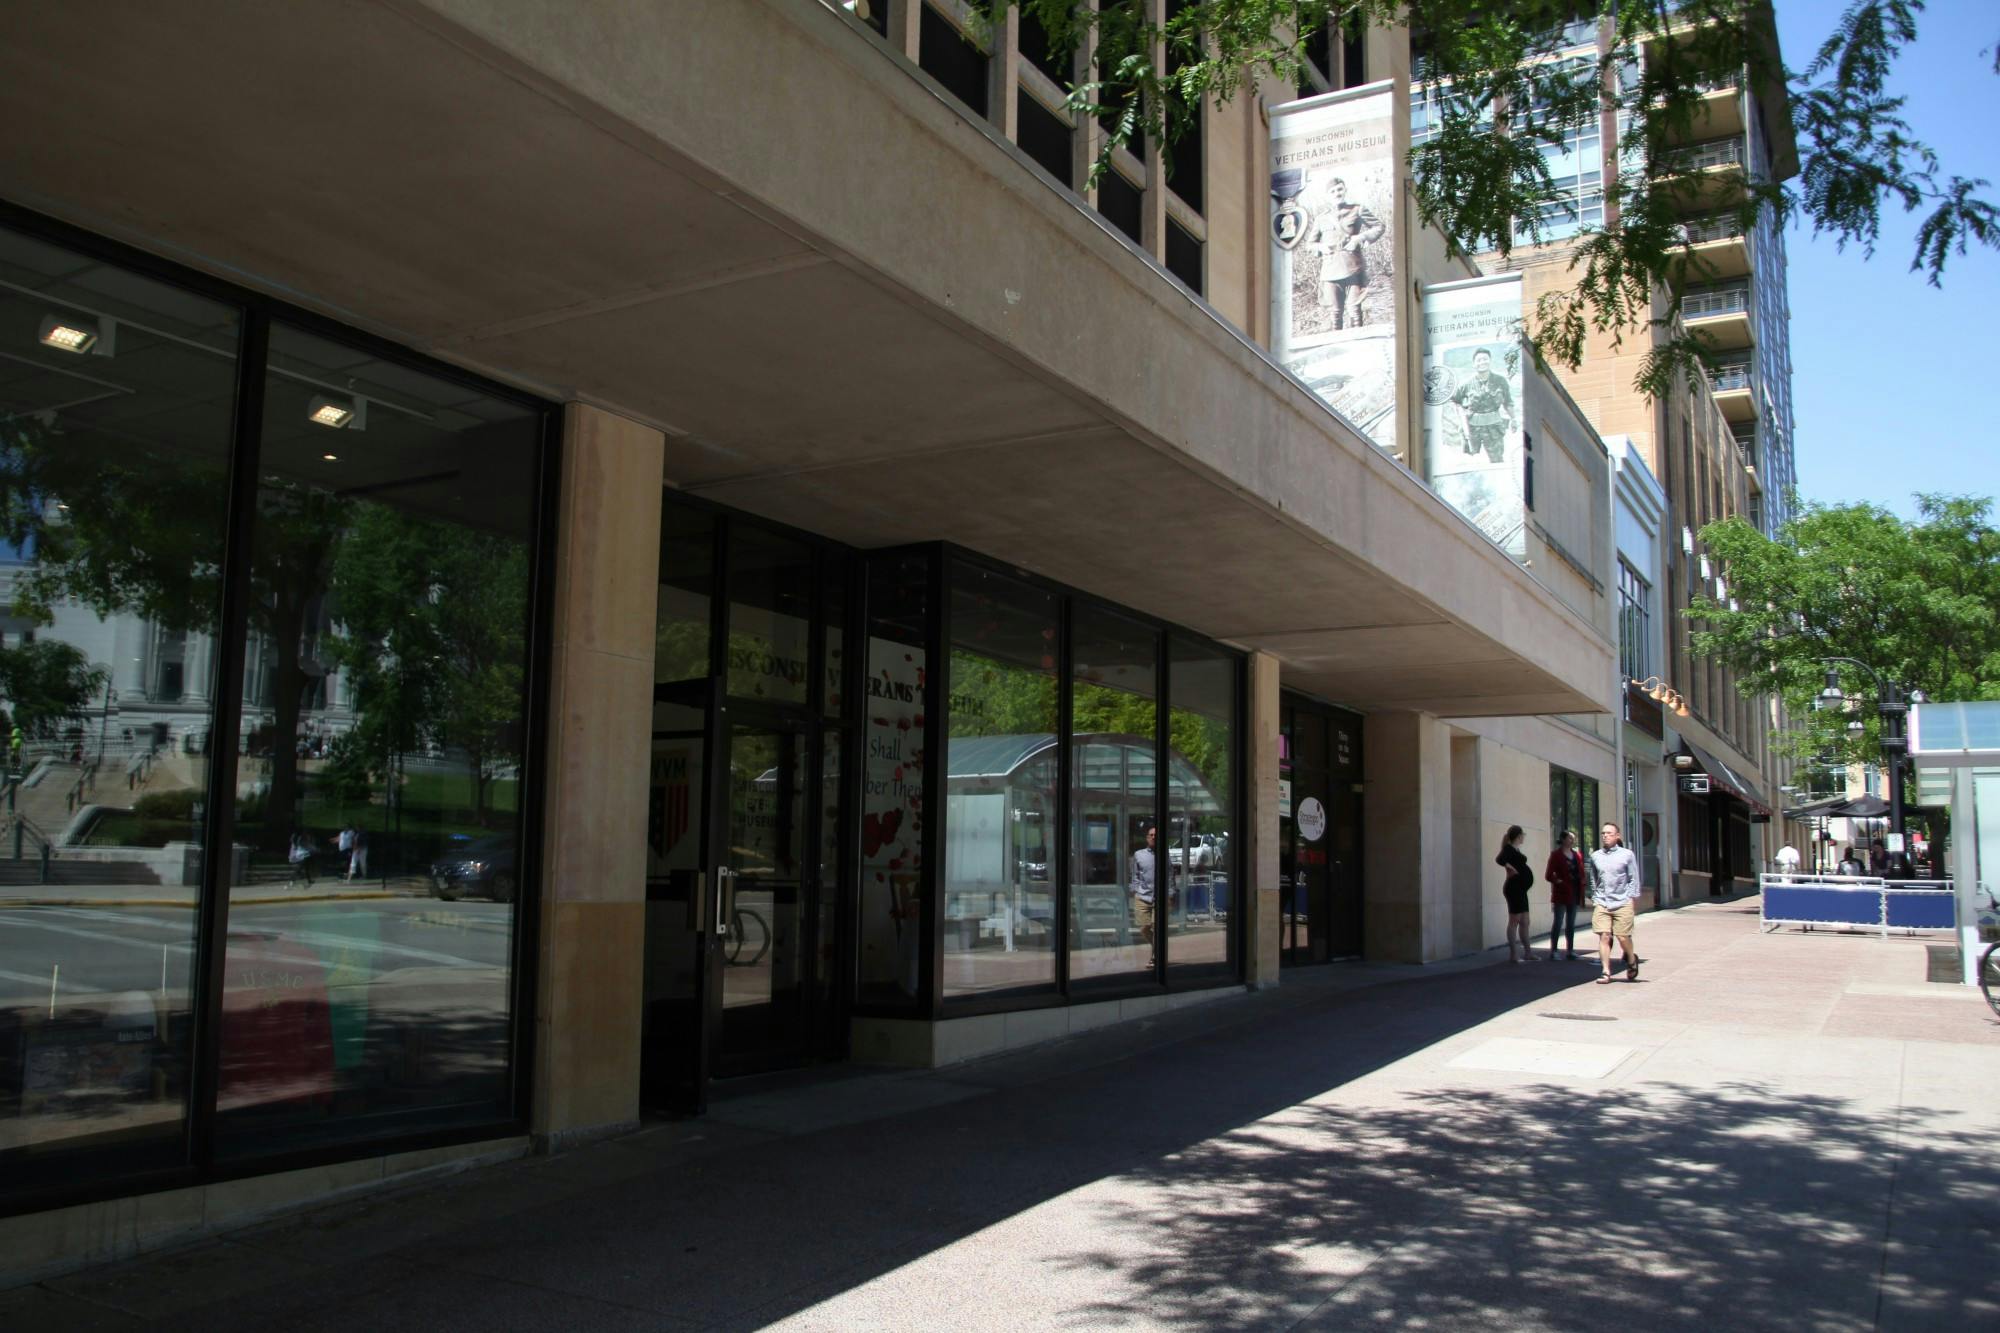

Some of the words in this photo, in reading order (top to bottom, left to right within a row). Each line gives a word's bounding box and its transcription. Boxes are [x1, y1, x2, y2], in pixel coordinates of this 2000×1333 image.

[1305, 128, 1354, 145] WISCONSIN
[1275, 145, 1334, 167] VETERANS
[1338, 134, 1387, 153] MUSEUM
[1427, 320, 1475, 336] VETERANS
[869, 736, 901, 761] Shall
